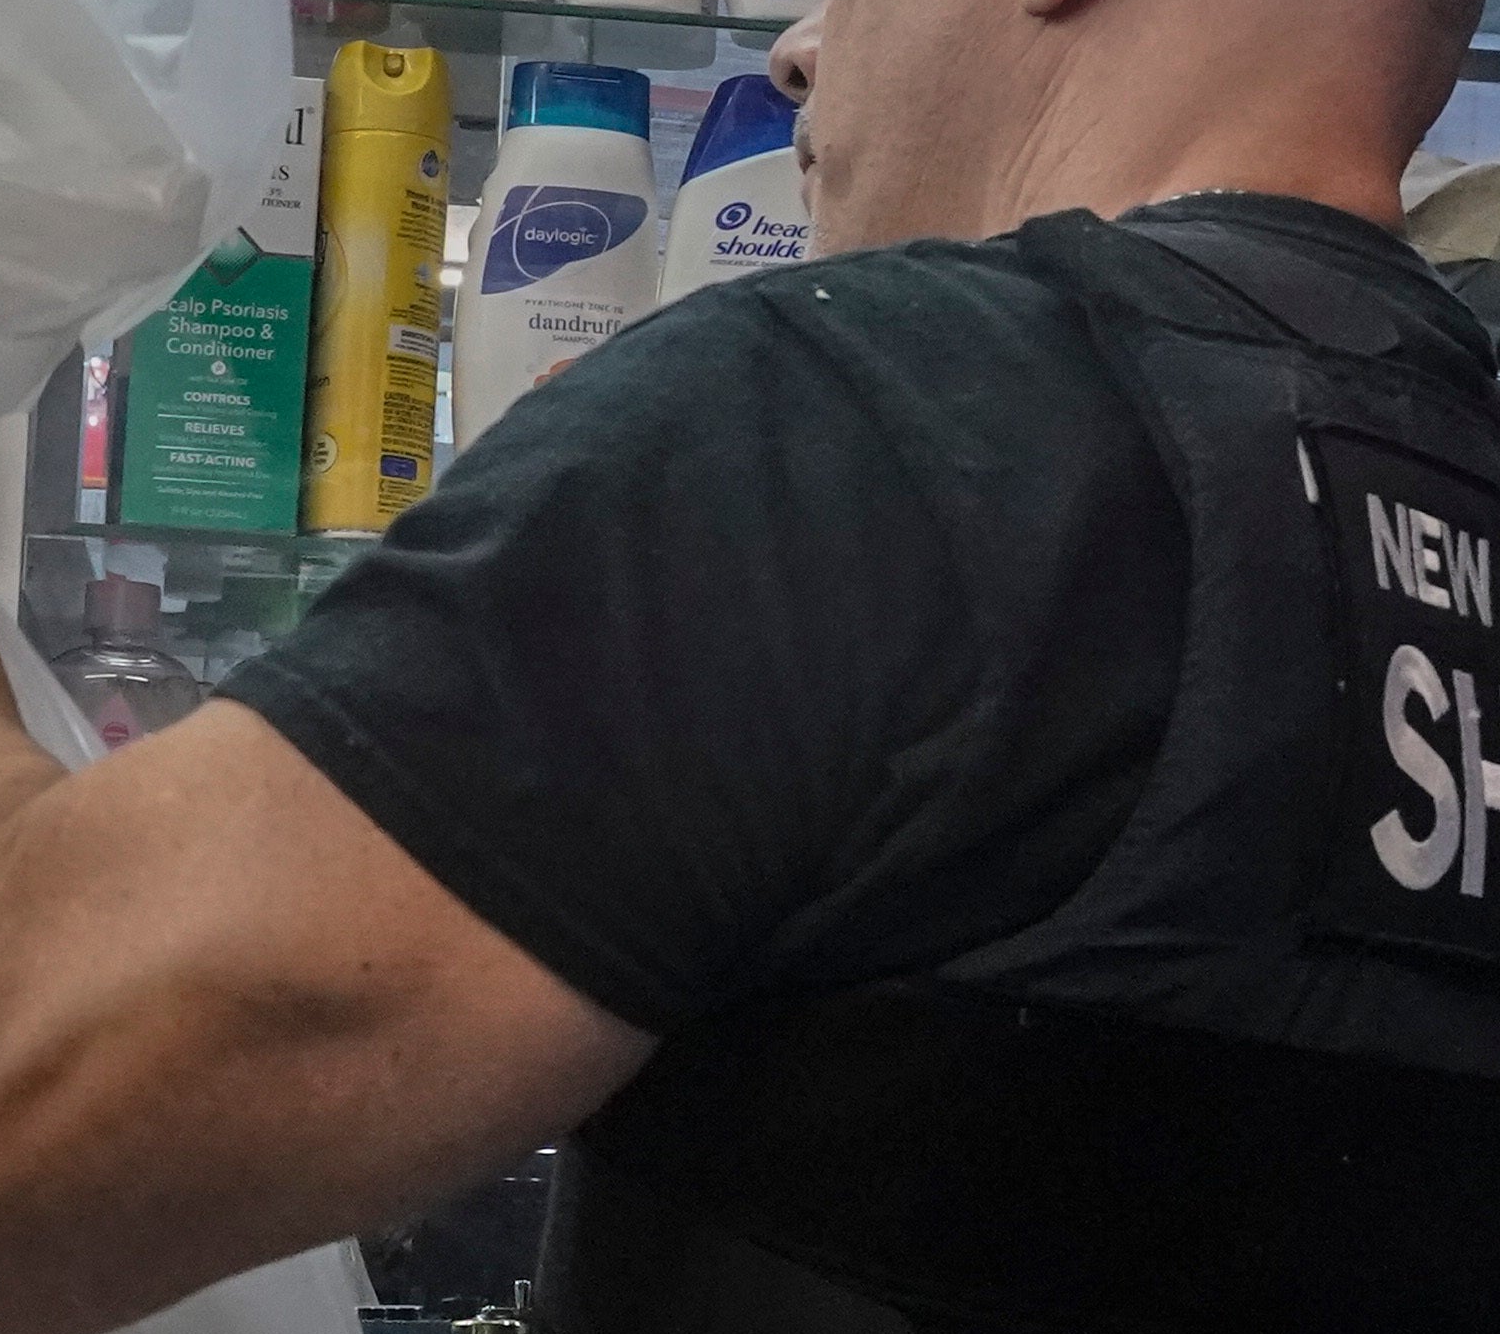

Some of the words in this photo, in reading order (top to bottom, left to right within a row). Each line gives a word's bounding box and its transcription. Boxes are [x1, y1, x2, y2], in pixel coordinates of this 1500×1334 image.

[524, 227, 595, 245] daylogic
[211, 298, 289, 321] Psoriasis
[525, 298, 584, 309] PYRITHIONE
[587, 300, 612, 310] ZINC
[168, 317, 256, 341] Shampoo
[260, 322, 275, 340] &
[528, 312, 621, 335] dandruff
[552, 333, 597, 345] SHAMPOO
[166, 336, 275, 362] Conditioner
[183, 391, 251, 406] CONTROLS
[184, 421, 246, 436] RELIEVES
[169, 451, 256, 468] FAST-ACTING
[1366, 492, 1493, 628] NEW
